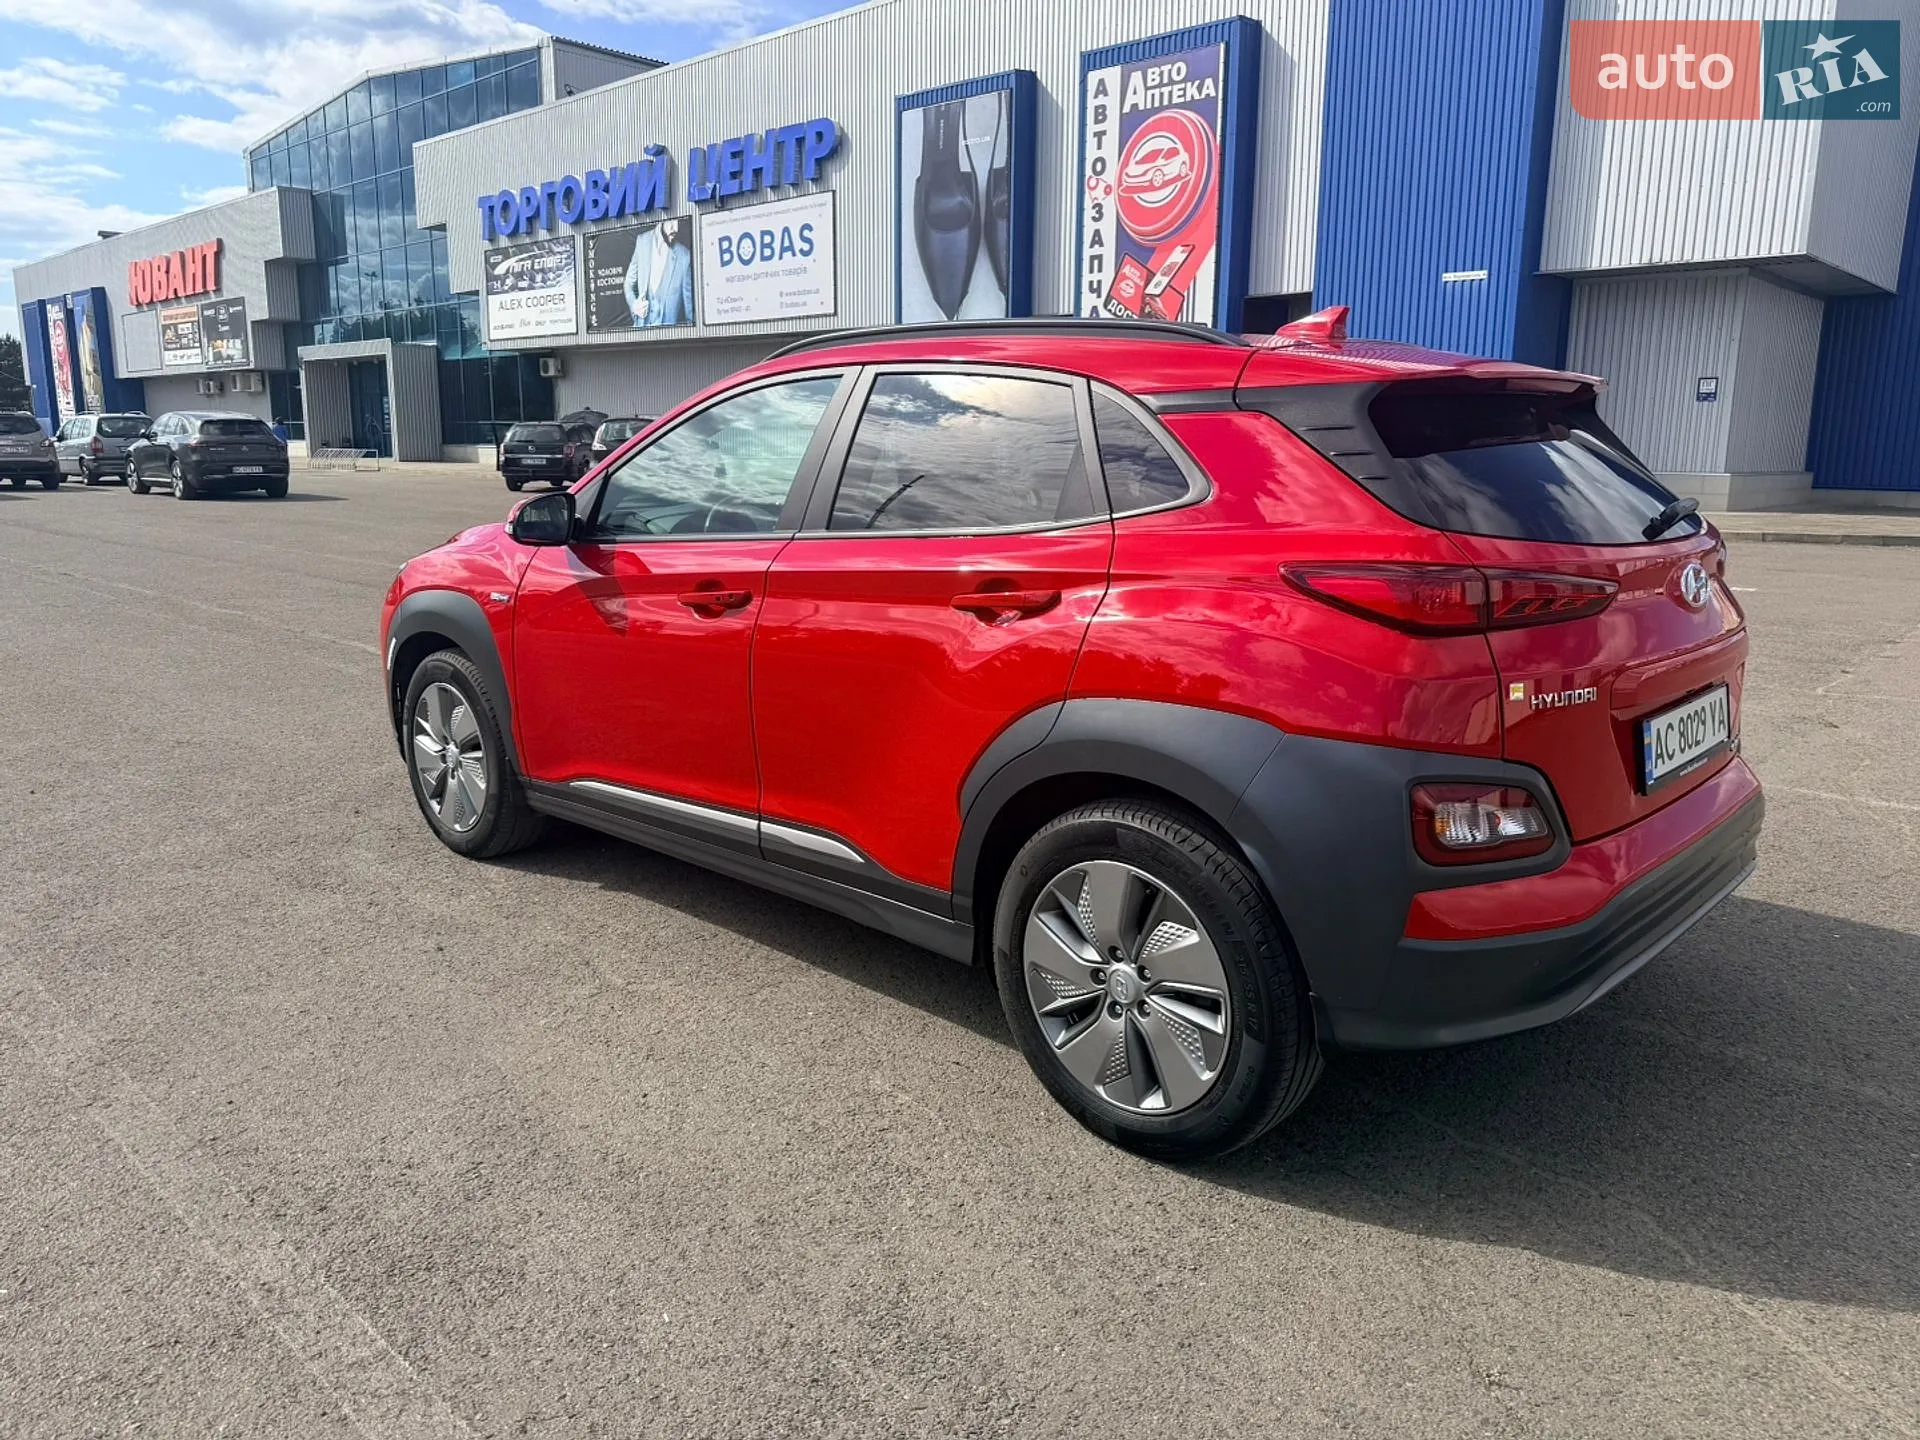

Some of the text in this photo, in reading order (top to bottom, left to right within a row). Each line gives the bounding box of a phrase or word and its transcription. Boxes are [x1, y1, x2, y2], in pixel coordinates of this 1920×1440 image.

[478, 117, 839, 241] ТОРГОВИЙ ЦЕНТР
[718, 222, 815, 268] BOBAS
[498, 298, 523, 312] ALEX
[525, 293, 566, 308] COOPER
[1107, 299, 1138, 319] ДОС
[1531, 686, 1598, 710] HYUNDAI
[1654, 722, 1676, 769] AC
[1678, 705, 1707, 755] 8029
[1709, 697, 1727, 737] YA
